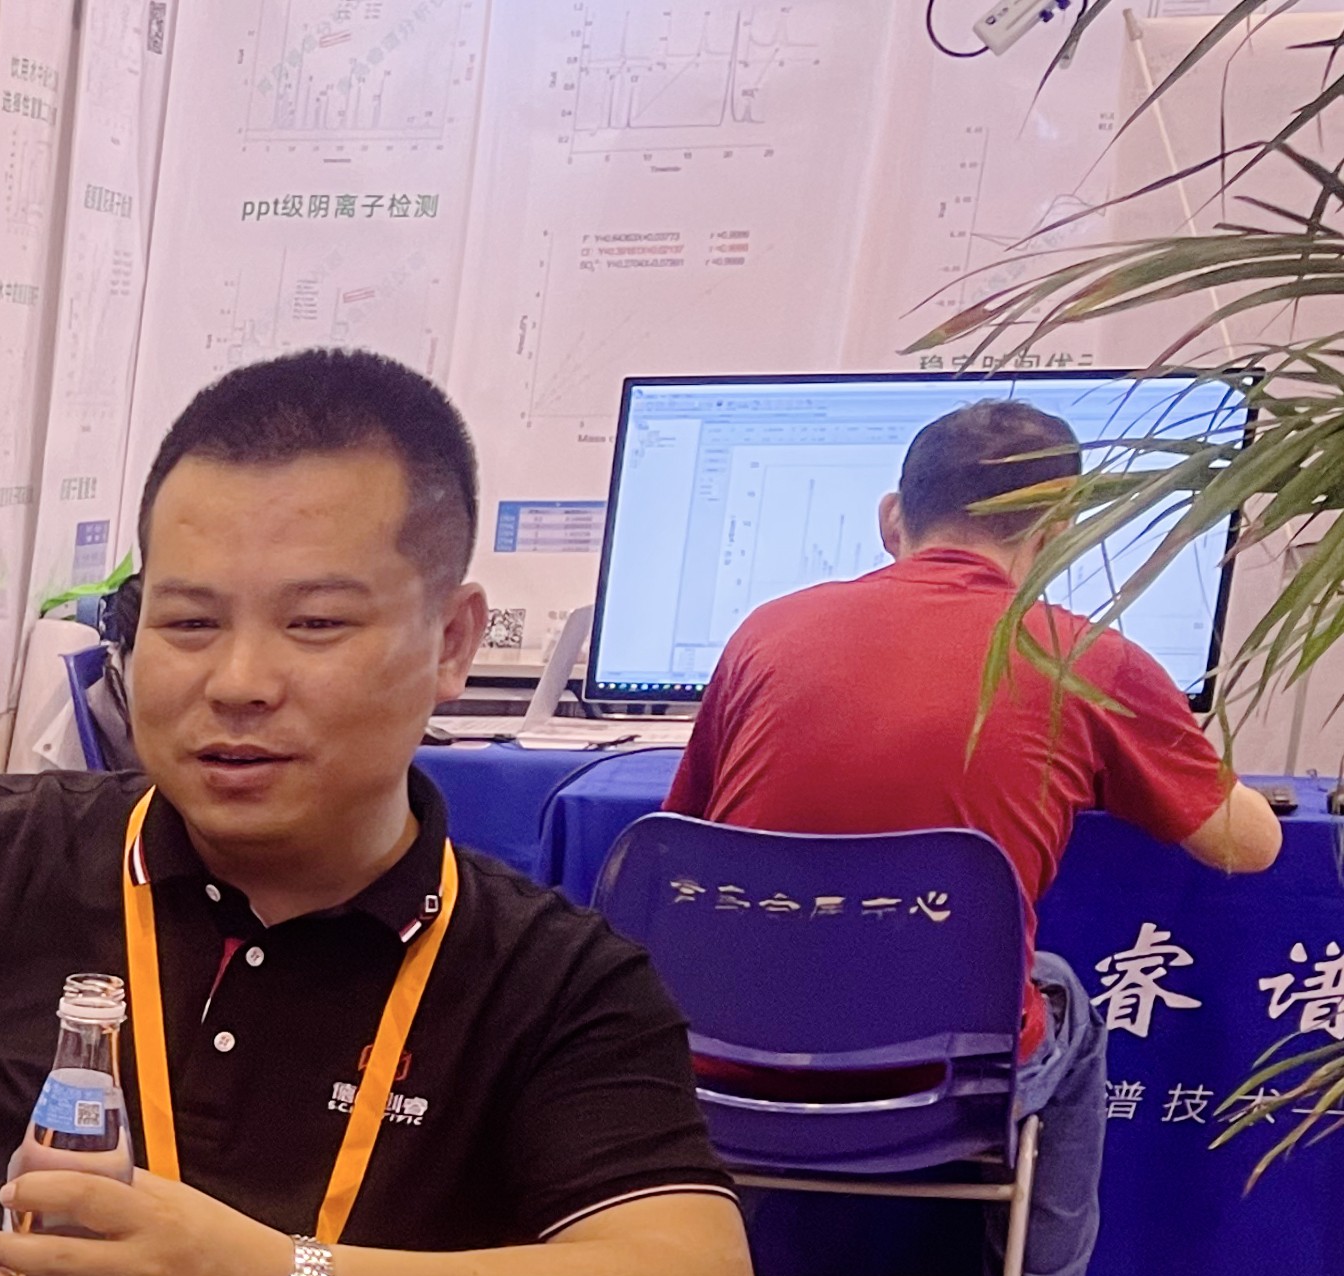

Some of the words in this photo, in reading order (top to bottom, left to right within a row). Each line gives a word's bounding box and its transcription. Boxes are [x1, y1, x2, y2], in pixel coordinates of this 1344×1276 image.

[241, 193, 440, 221] ppt级阴离子检测
